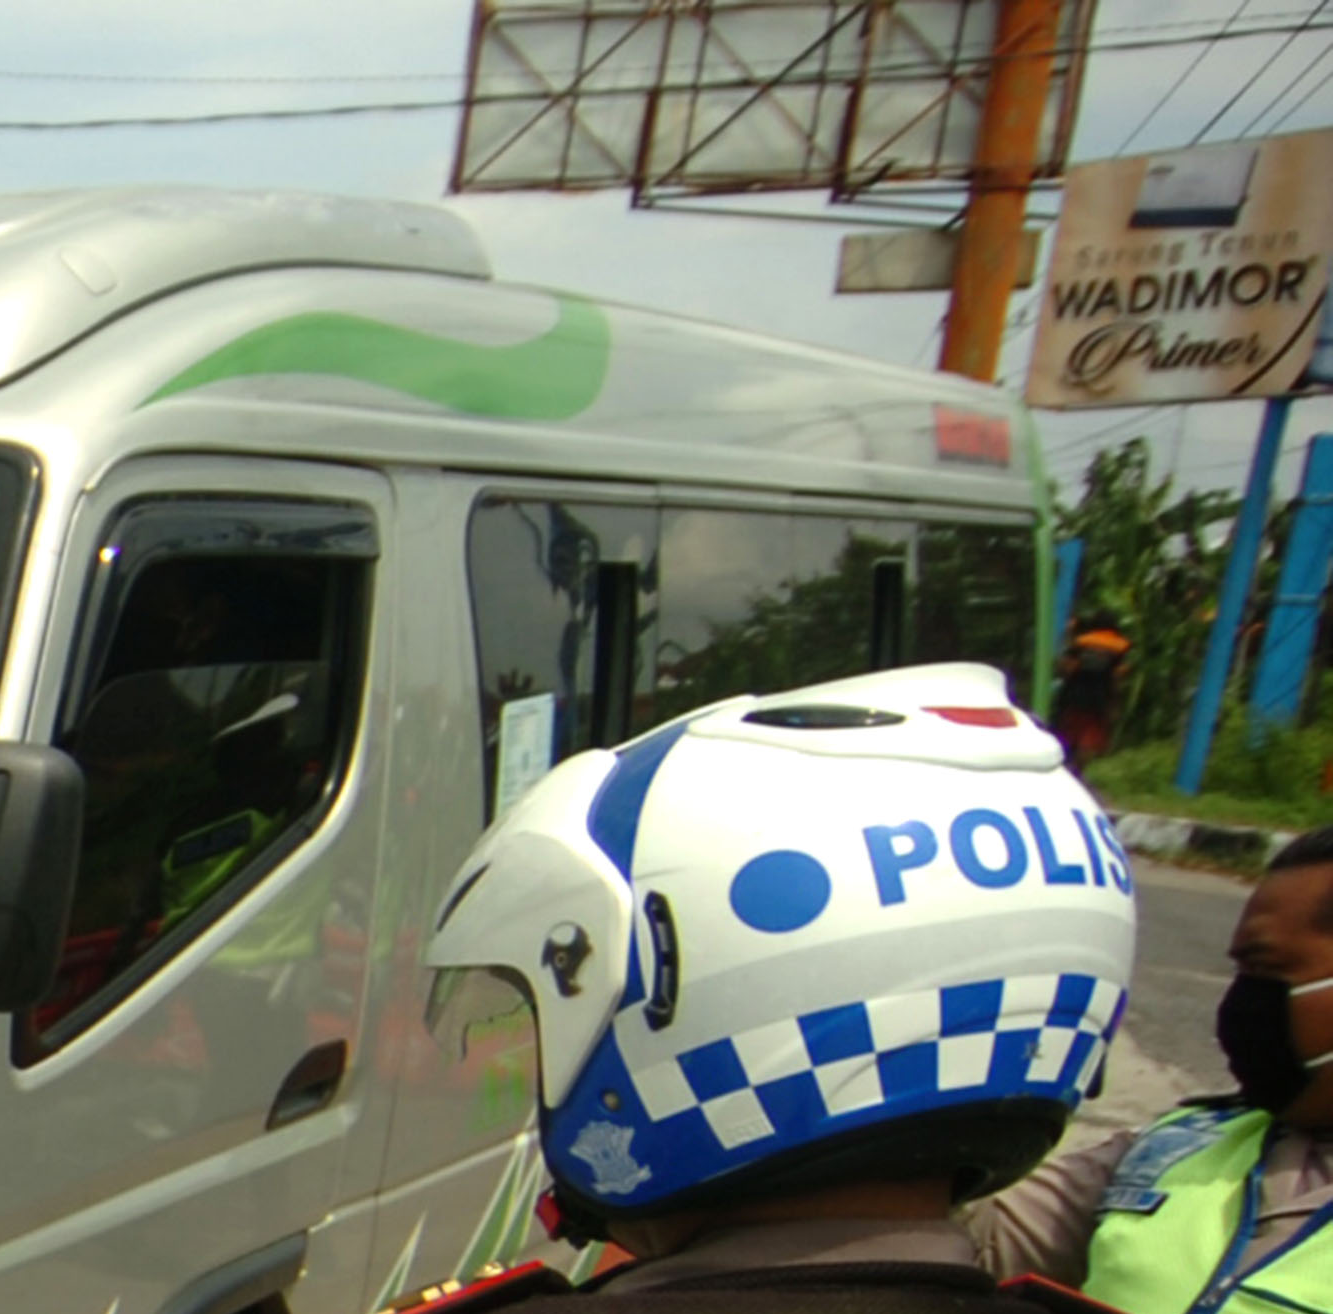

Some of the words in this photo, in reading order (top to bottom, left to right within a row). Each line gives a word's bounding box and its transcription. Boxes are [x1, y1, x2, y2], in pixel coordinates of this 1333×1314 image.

[1200, 230, 1298, 256] Tenun
[1053, 260, 1310, 320] WADIMOR
[1061, 320, 1265, 394] Primer
